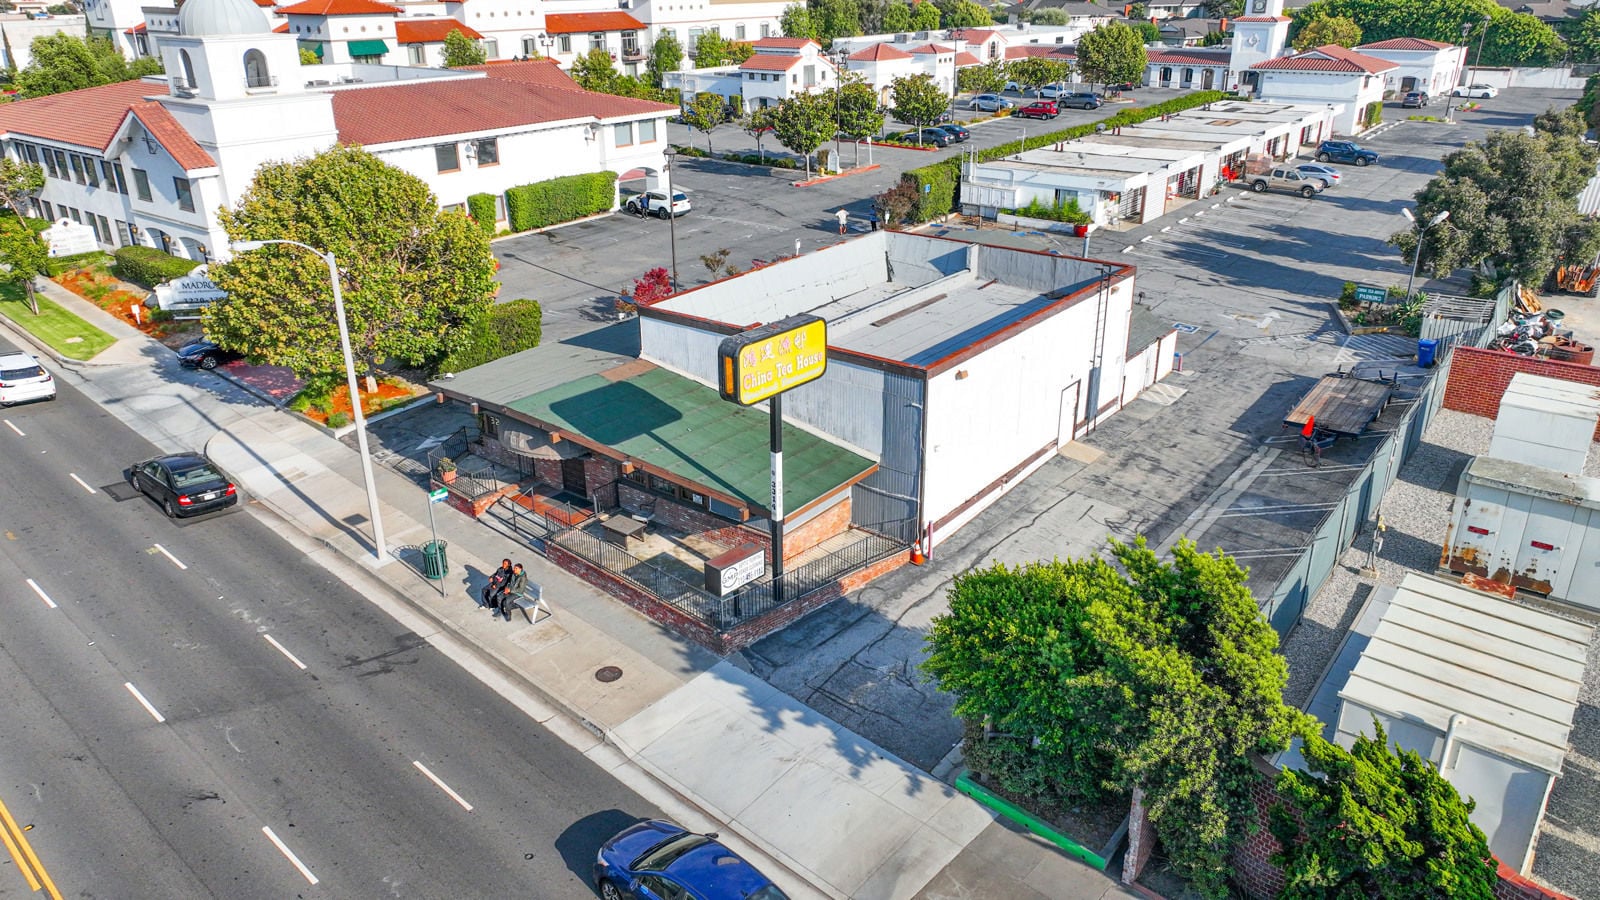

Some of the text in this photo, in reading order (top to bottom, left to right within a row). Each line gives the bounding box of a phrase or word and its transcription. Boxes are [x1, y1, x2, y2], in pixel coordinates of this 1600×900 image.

[744, 371, 772, 390] China
[776, 362, 793, 377] Tea
[797, 353, 822, 370] House
